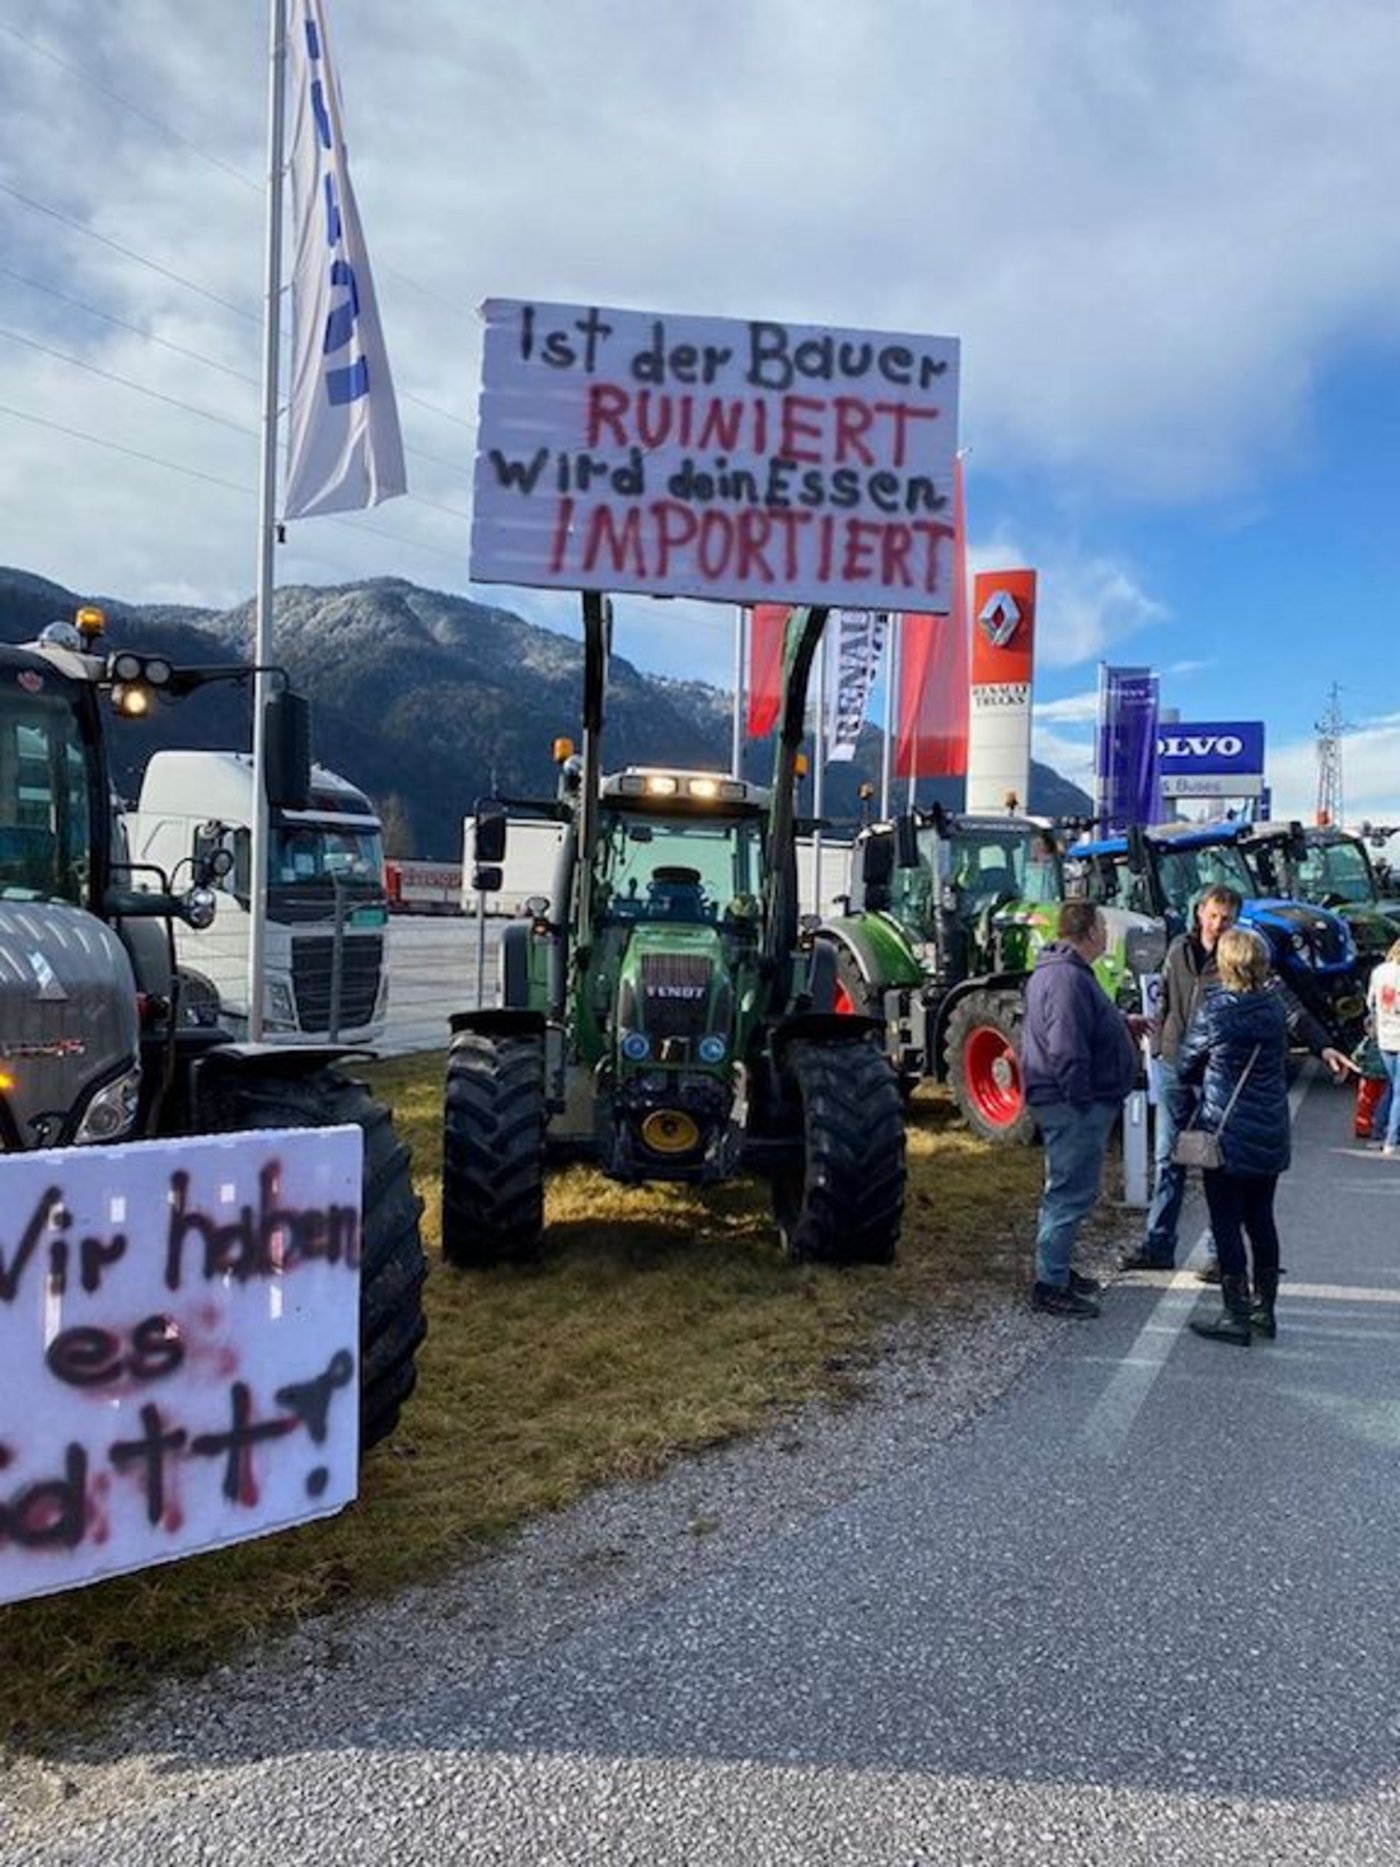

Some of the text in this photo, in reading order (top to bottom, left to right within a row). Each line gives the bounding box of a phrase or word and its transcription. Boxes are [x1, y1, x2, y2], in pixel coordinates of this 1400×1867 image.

[519, 305, 948, 390] Ist der Bauer
[585, 383, 940, 467] RUINIERT
[667, 457, 758, 503] dein
[764, 456, 947, 514] Essen
[549, 497, 956, 594] IMPORTIERT
[1157, 736, 1243, 757] LVO
[166, 1159, 362, 1291] haben
[46, 1314, 185, 1388] es
